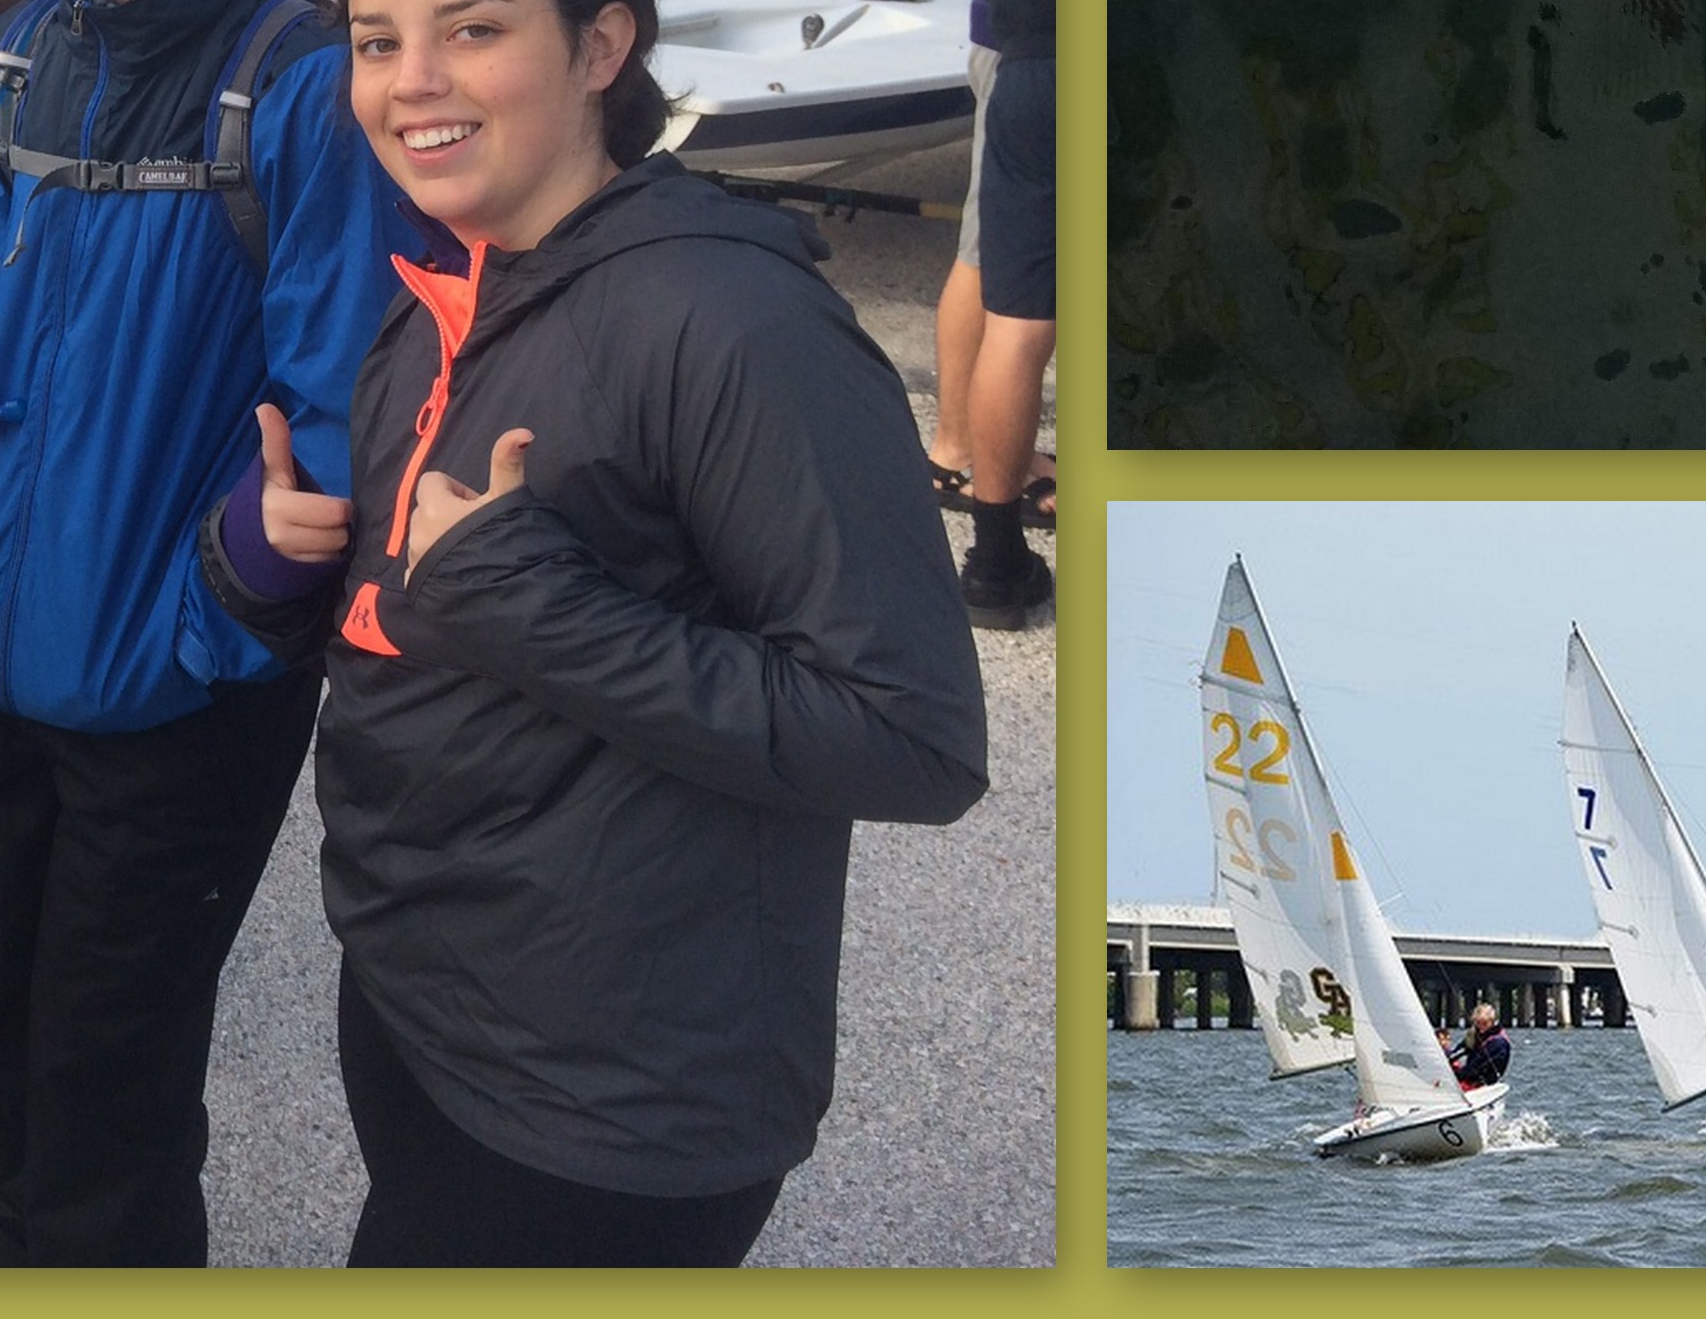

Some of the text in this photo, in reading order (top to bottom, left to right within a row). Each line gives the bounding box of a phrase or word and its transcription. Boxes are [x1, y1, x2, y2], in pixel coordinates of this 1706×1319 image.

[1210, 712, 1291, 786] 22
[1577, 787, 1596, 829] 7
[1438, 1118, 1464, 1147] 6
